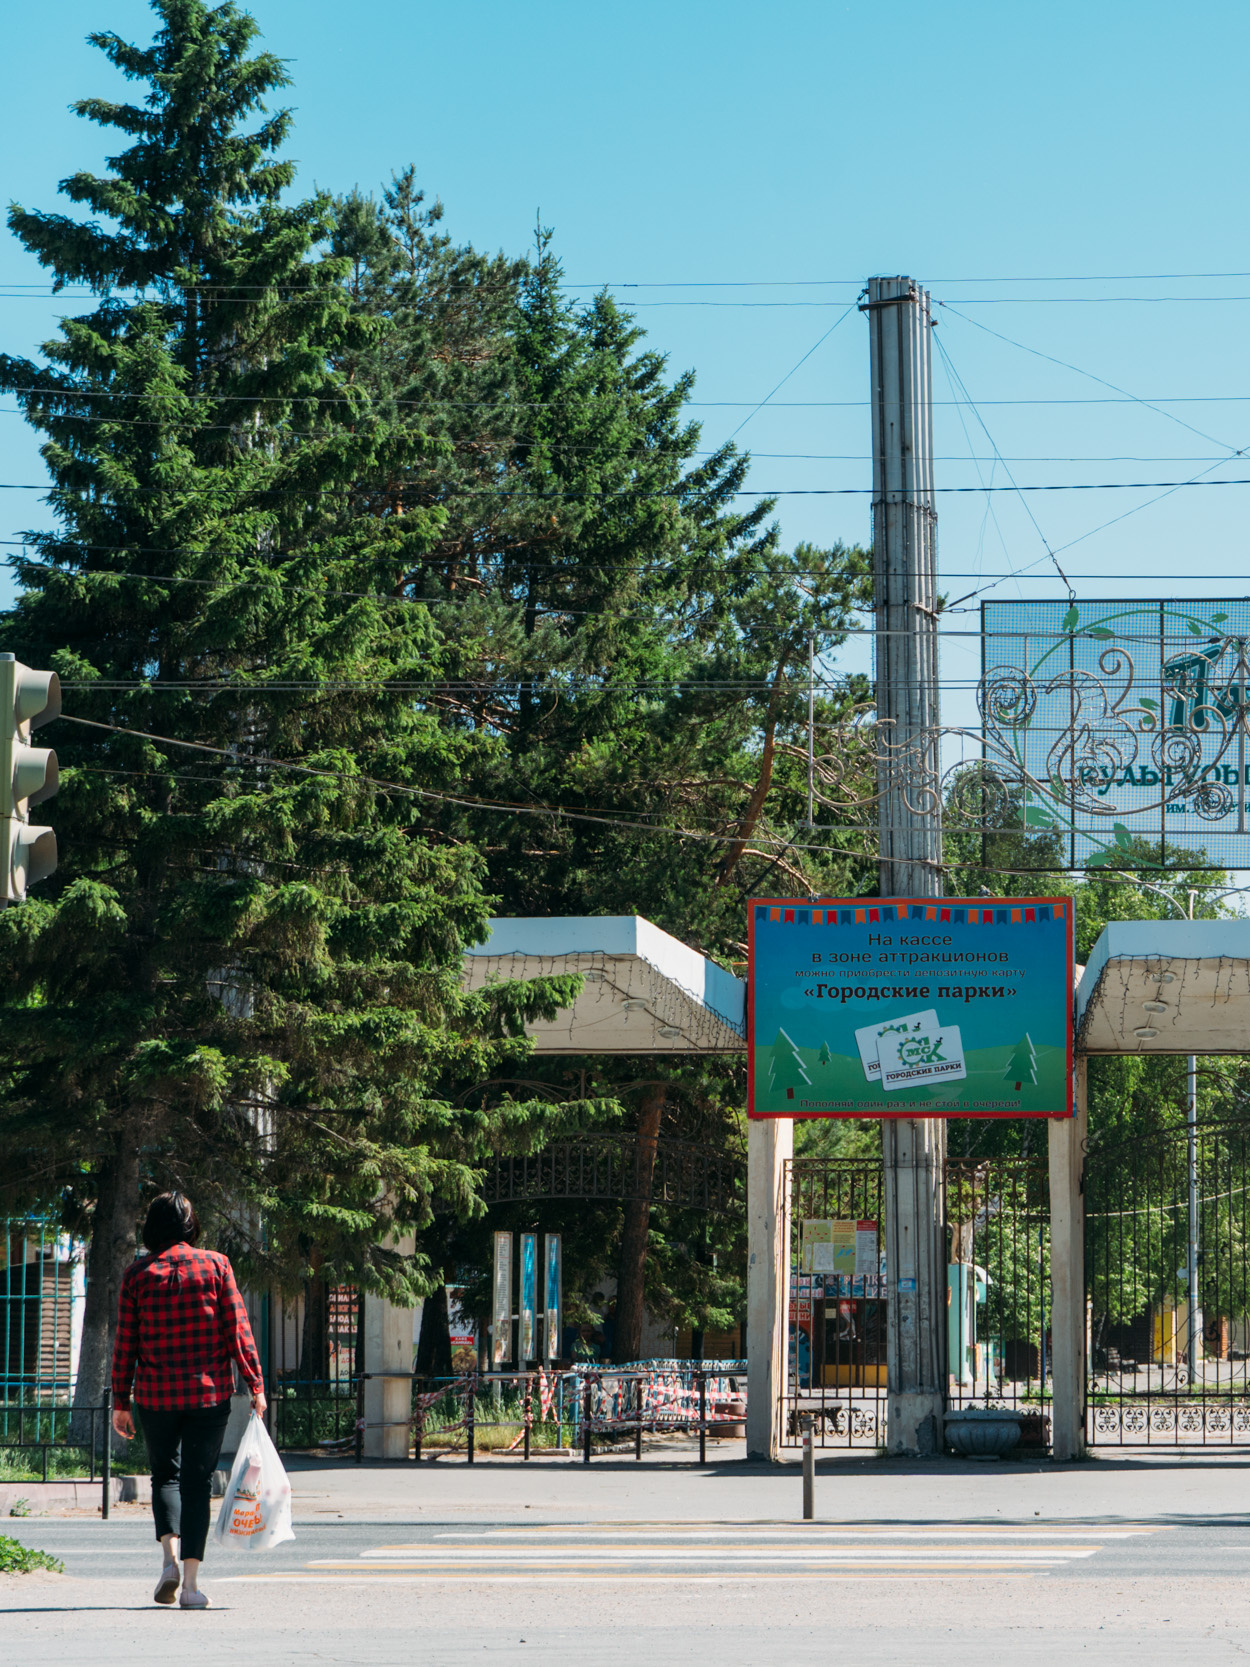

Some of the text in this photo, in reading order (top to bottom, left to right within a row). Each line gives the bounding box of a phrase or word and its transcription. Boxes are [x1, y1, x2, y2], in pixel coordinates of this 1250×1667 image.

[1165, 804, 1190, 814] им.
[868, 934, 952, 946] На кассе
[812, 952, 1009, 965] в зоне аттракционов
[839, 970, 910, 978] приобрести
[915, 970, 988, 978] депозитную
[992, 970, 1026, 978] карту
[804, 984, 1017, 1003] «Городские парки»
[886, 1063, 962, 1080] ГОРОДСКИЕ ПАРКИ
